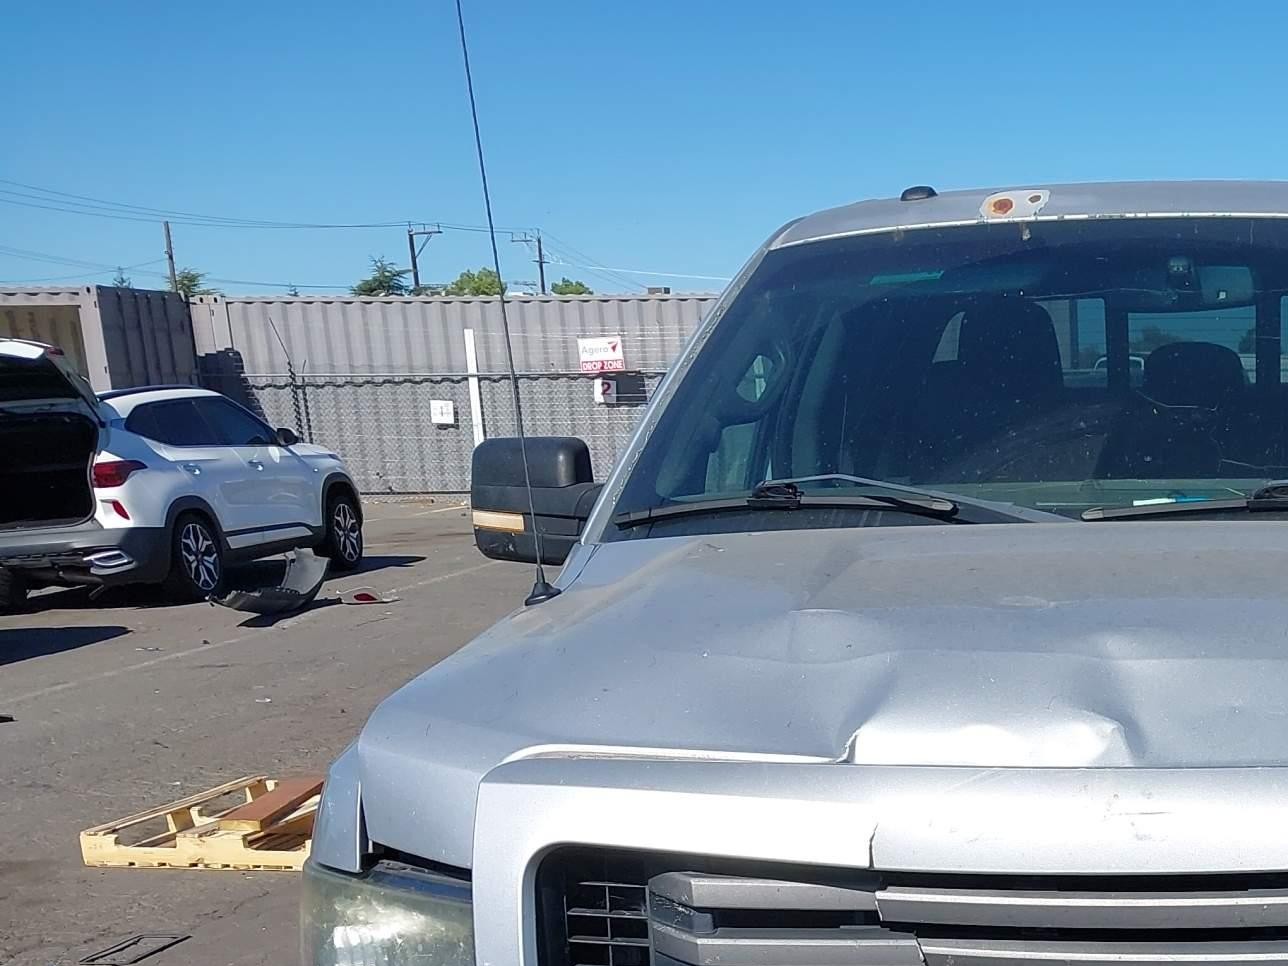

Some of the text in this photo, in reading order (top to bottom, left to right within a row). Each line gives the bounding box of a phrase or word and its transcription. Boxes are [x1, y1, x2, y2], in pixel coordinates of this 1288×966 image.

[582, 345, 609, 355] Agero
[582, 360, 623, 371] DROP ZONE
[601, 381, 612, 396] 2
